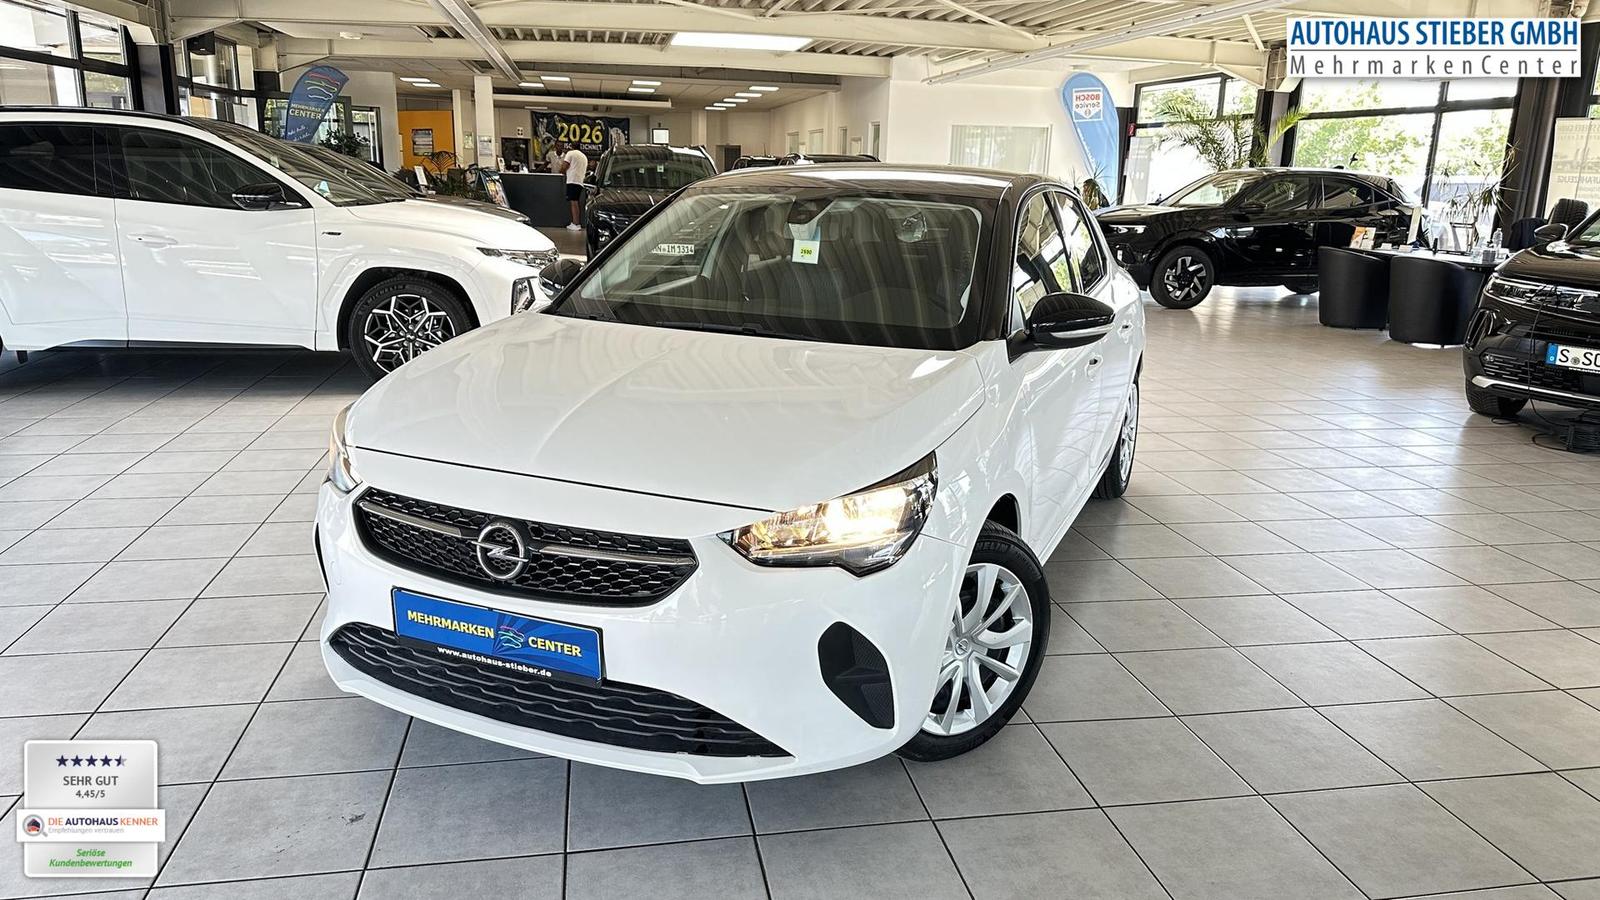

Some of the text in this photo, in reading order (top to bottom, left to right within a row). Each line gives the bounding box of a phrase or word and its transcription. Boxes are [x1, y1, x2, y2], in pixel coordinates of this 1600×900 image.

[289, 108, 322, 119] CENTER
[558, 122, 603, 144] 2026
[1558, 348, 1570, 363] S
[407, 610, 582, 657] MEHRMARKEN CENTER
[437, 646, 552, 677] www.autohaus-stieber.de
